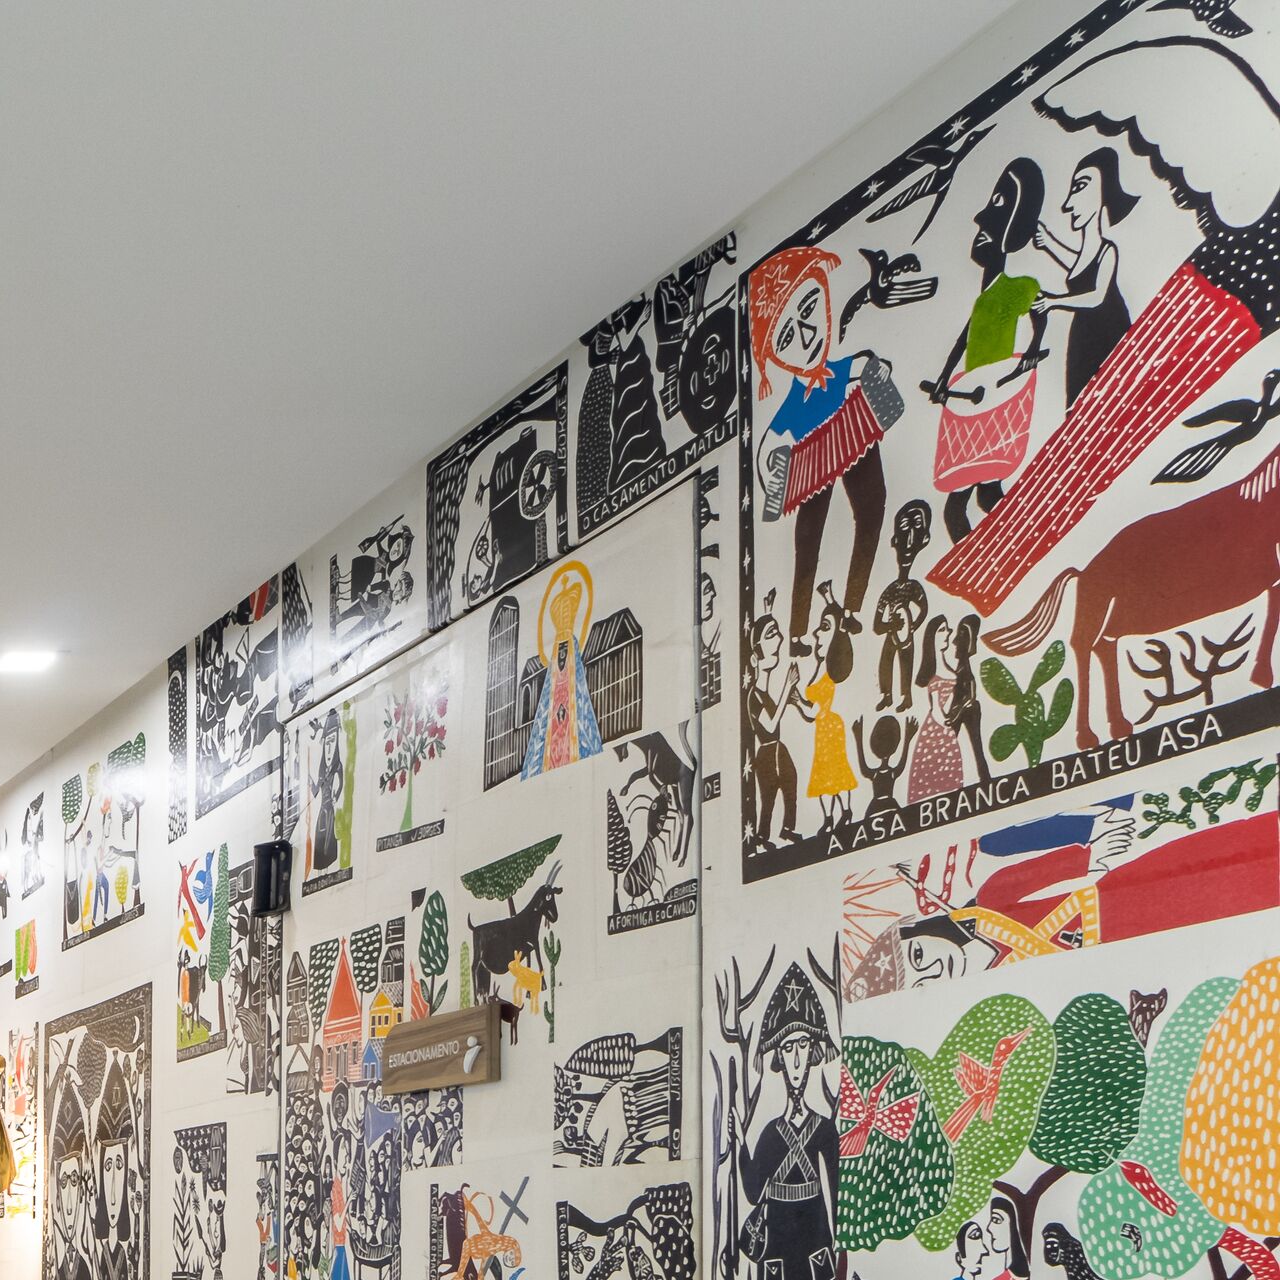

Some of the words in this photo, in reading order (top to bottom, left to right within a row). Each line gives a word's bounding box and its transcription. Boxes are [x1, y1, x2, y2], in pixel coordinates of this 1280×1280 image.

[582, 516, 590, 530] O
[593, 458, 676, 523] CASAMENTO
[684, 415, 737, 465] MATUT
[827, 834, 843, 855] A
[852, 813, 906, 848] ASA
[919, 775, 1030, 828] BRANCA
[1052, 739, 1141, 790] BATEU
[1157, 713, 1223, 757] ASA
[616, 913, 653, 929] FORMIGA
[666, 899, 696, 918] CAVALO
[389, 1040, 460, 1068] ESTACIONAMENTO
[670, 1032, 681, 1101] J.BORGES
[671, 1128, 681, 1158] SCO
